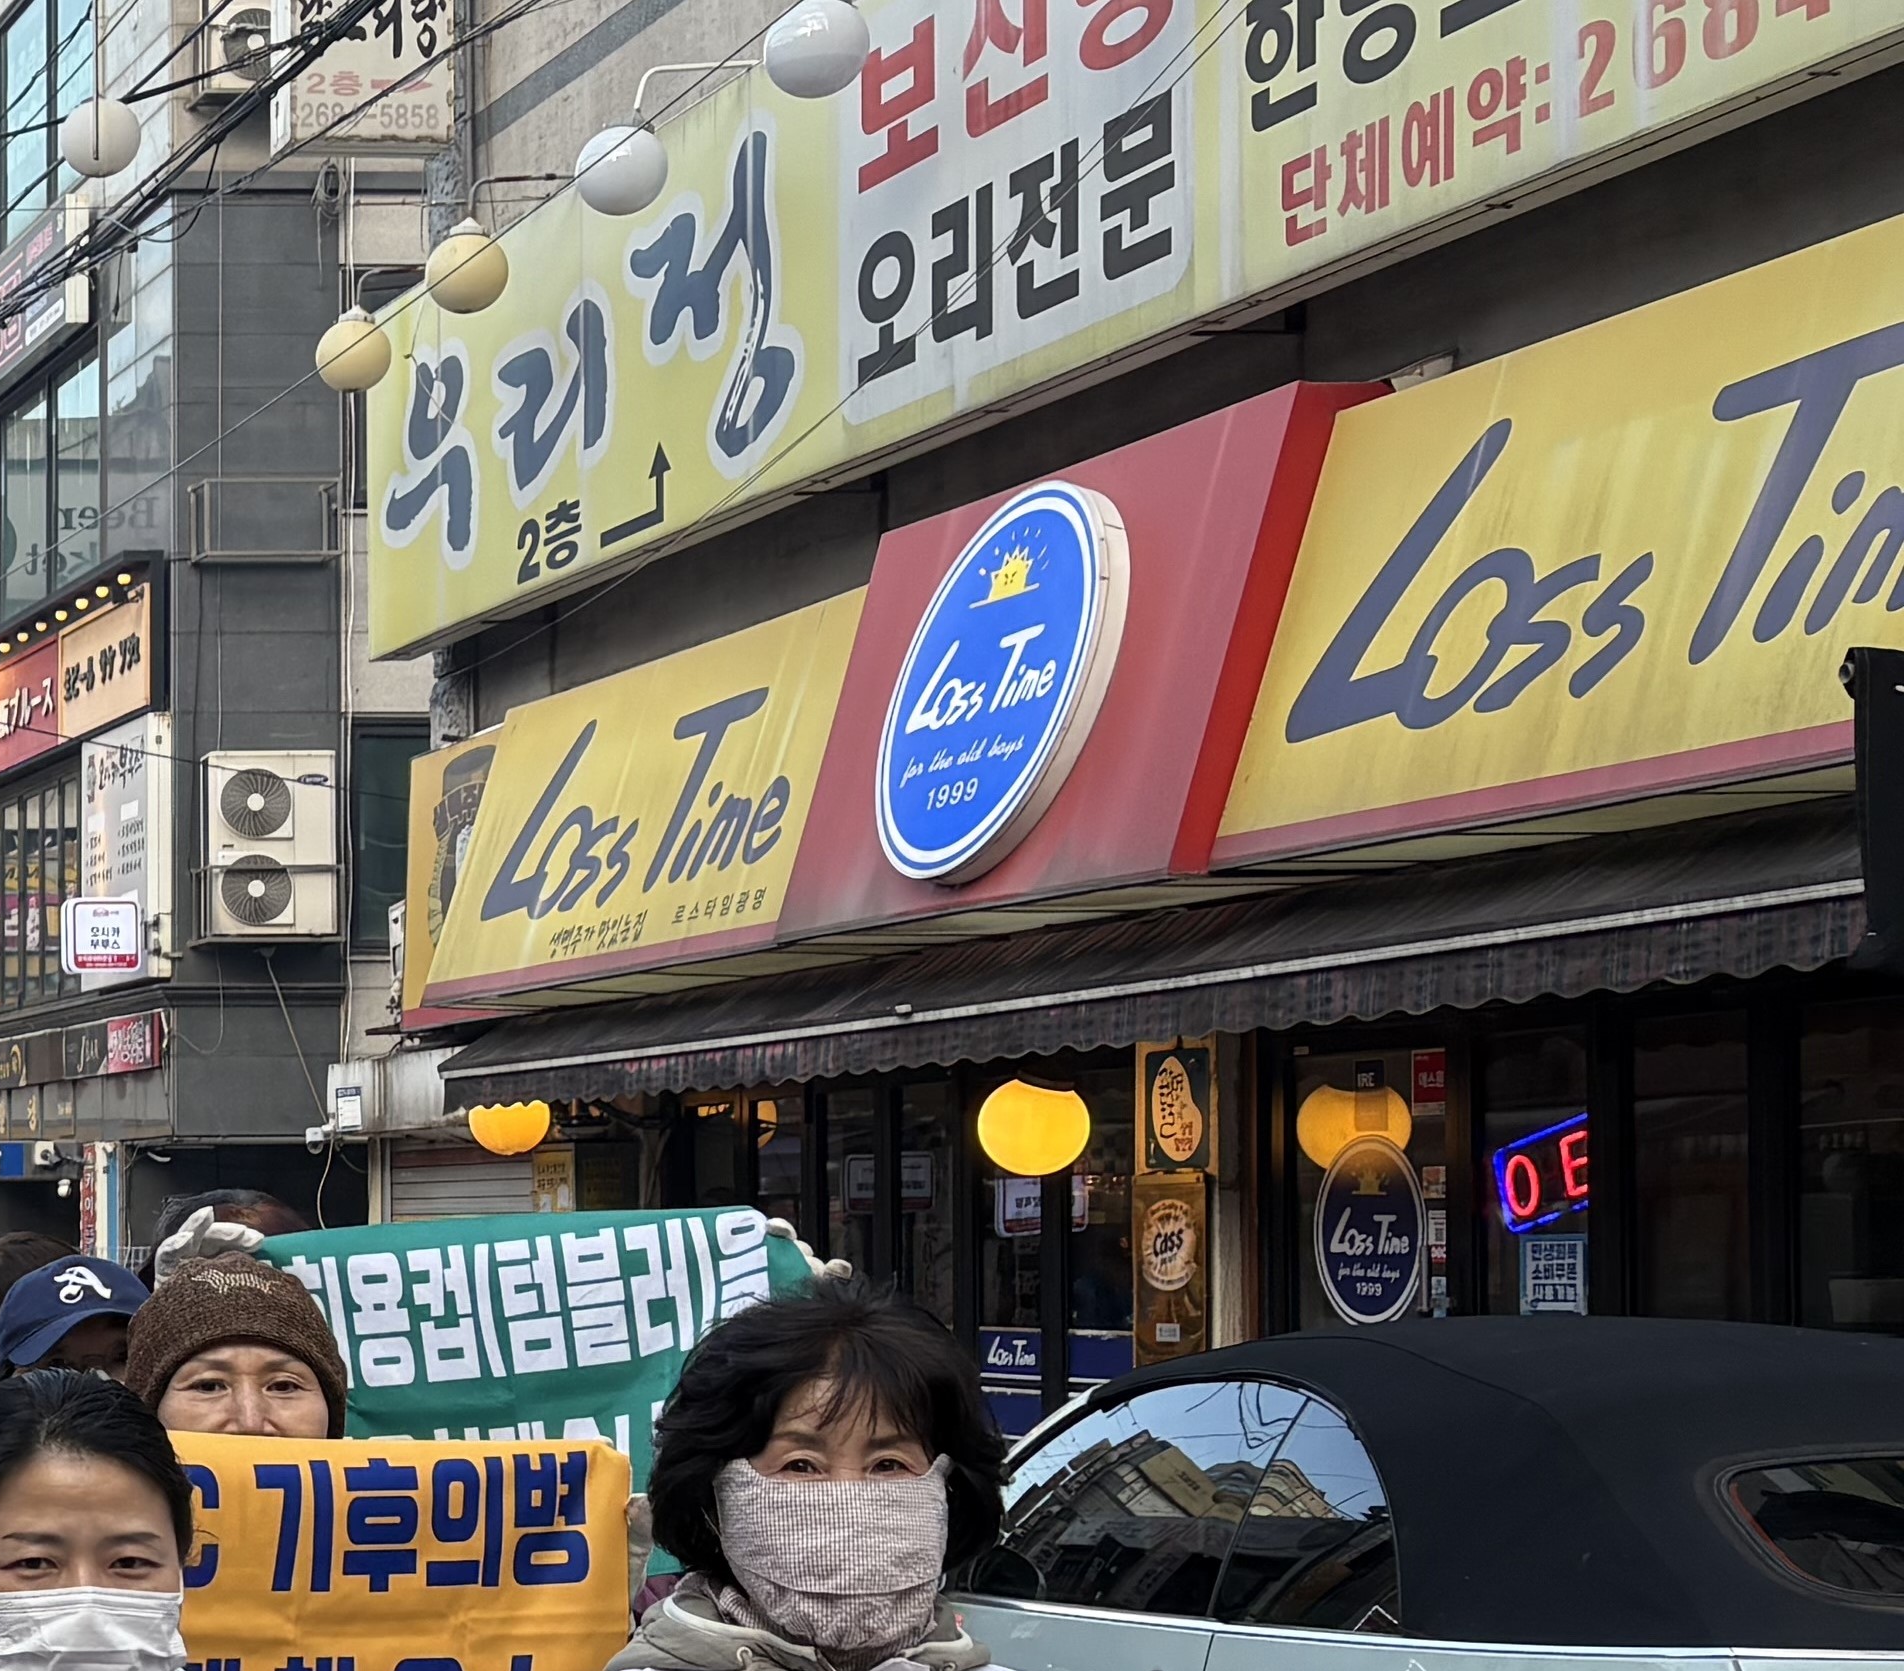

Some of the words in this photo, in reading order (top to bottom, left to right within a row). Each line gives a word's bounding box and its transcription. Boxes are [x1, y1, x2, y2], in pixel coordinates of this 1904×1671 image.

[306, 71, 362, 96] 2층
[856, 88, 1176, 388] 오리전문
[386, 130, 796, 552] 우리정
[515, 498, 584, 586] 2층
[1285, 417, 1656, 745] Loss
[905, 639, 983, 735] Loss
[989, 623, 1058, 714] Time
[480, 718, 640, 923] Loss
[642, 686, 791, 894] Time
[899, 757, 925, 790] for
[928, 746, 954, 778] the
[957, 737, 983, 767] old
[988, 733, 1024, 760] boys
[926, 777, 979, 811] 1999
[1329, 1206, 1374, 1257] Loss
[1373, 1214, 1410, 1255] Time
[1355, 1281, 1383, 1298] 1999
[254, 1449, 591, 1594] 기후의병
